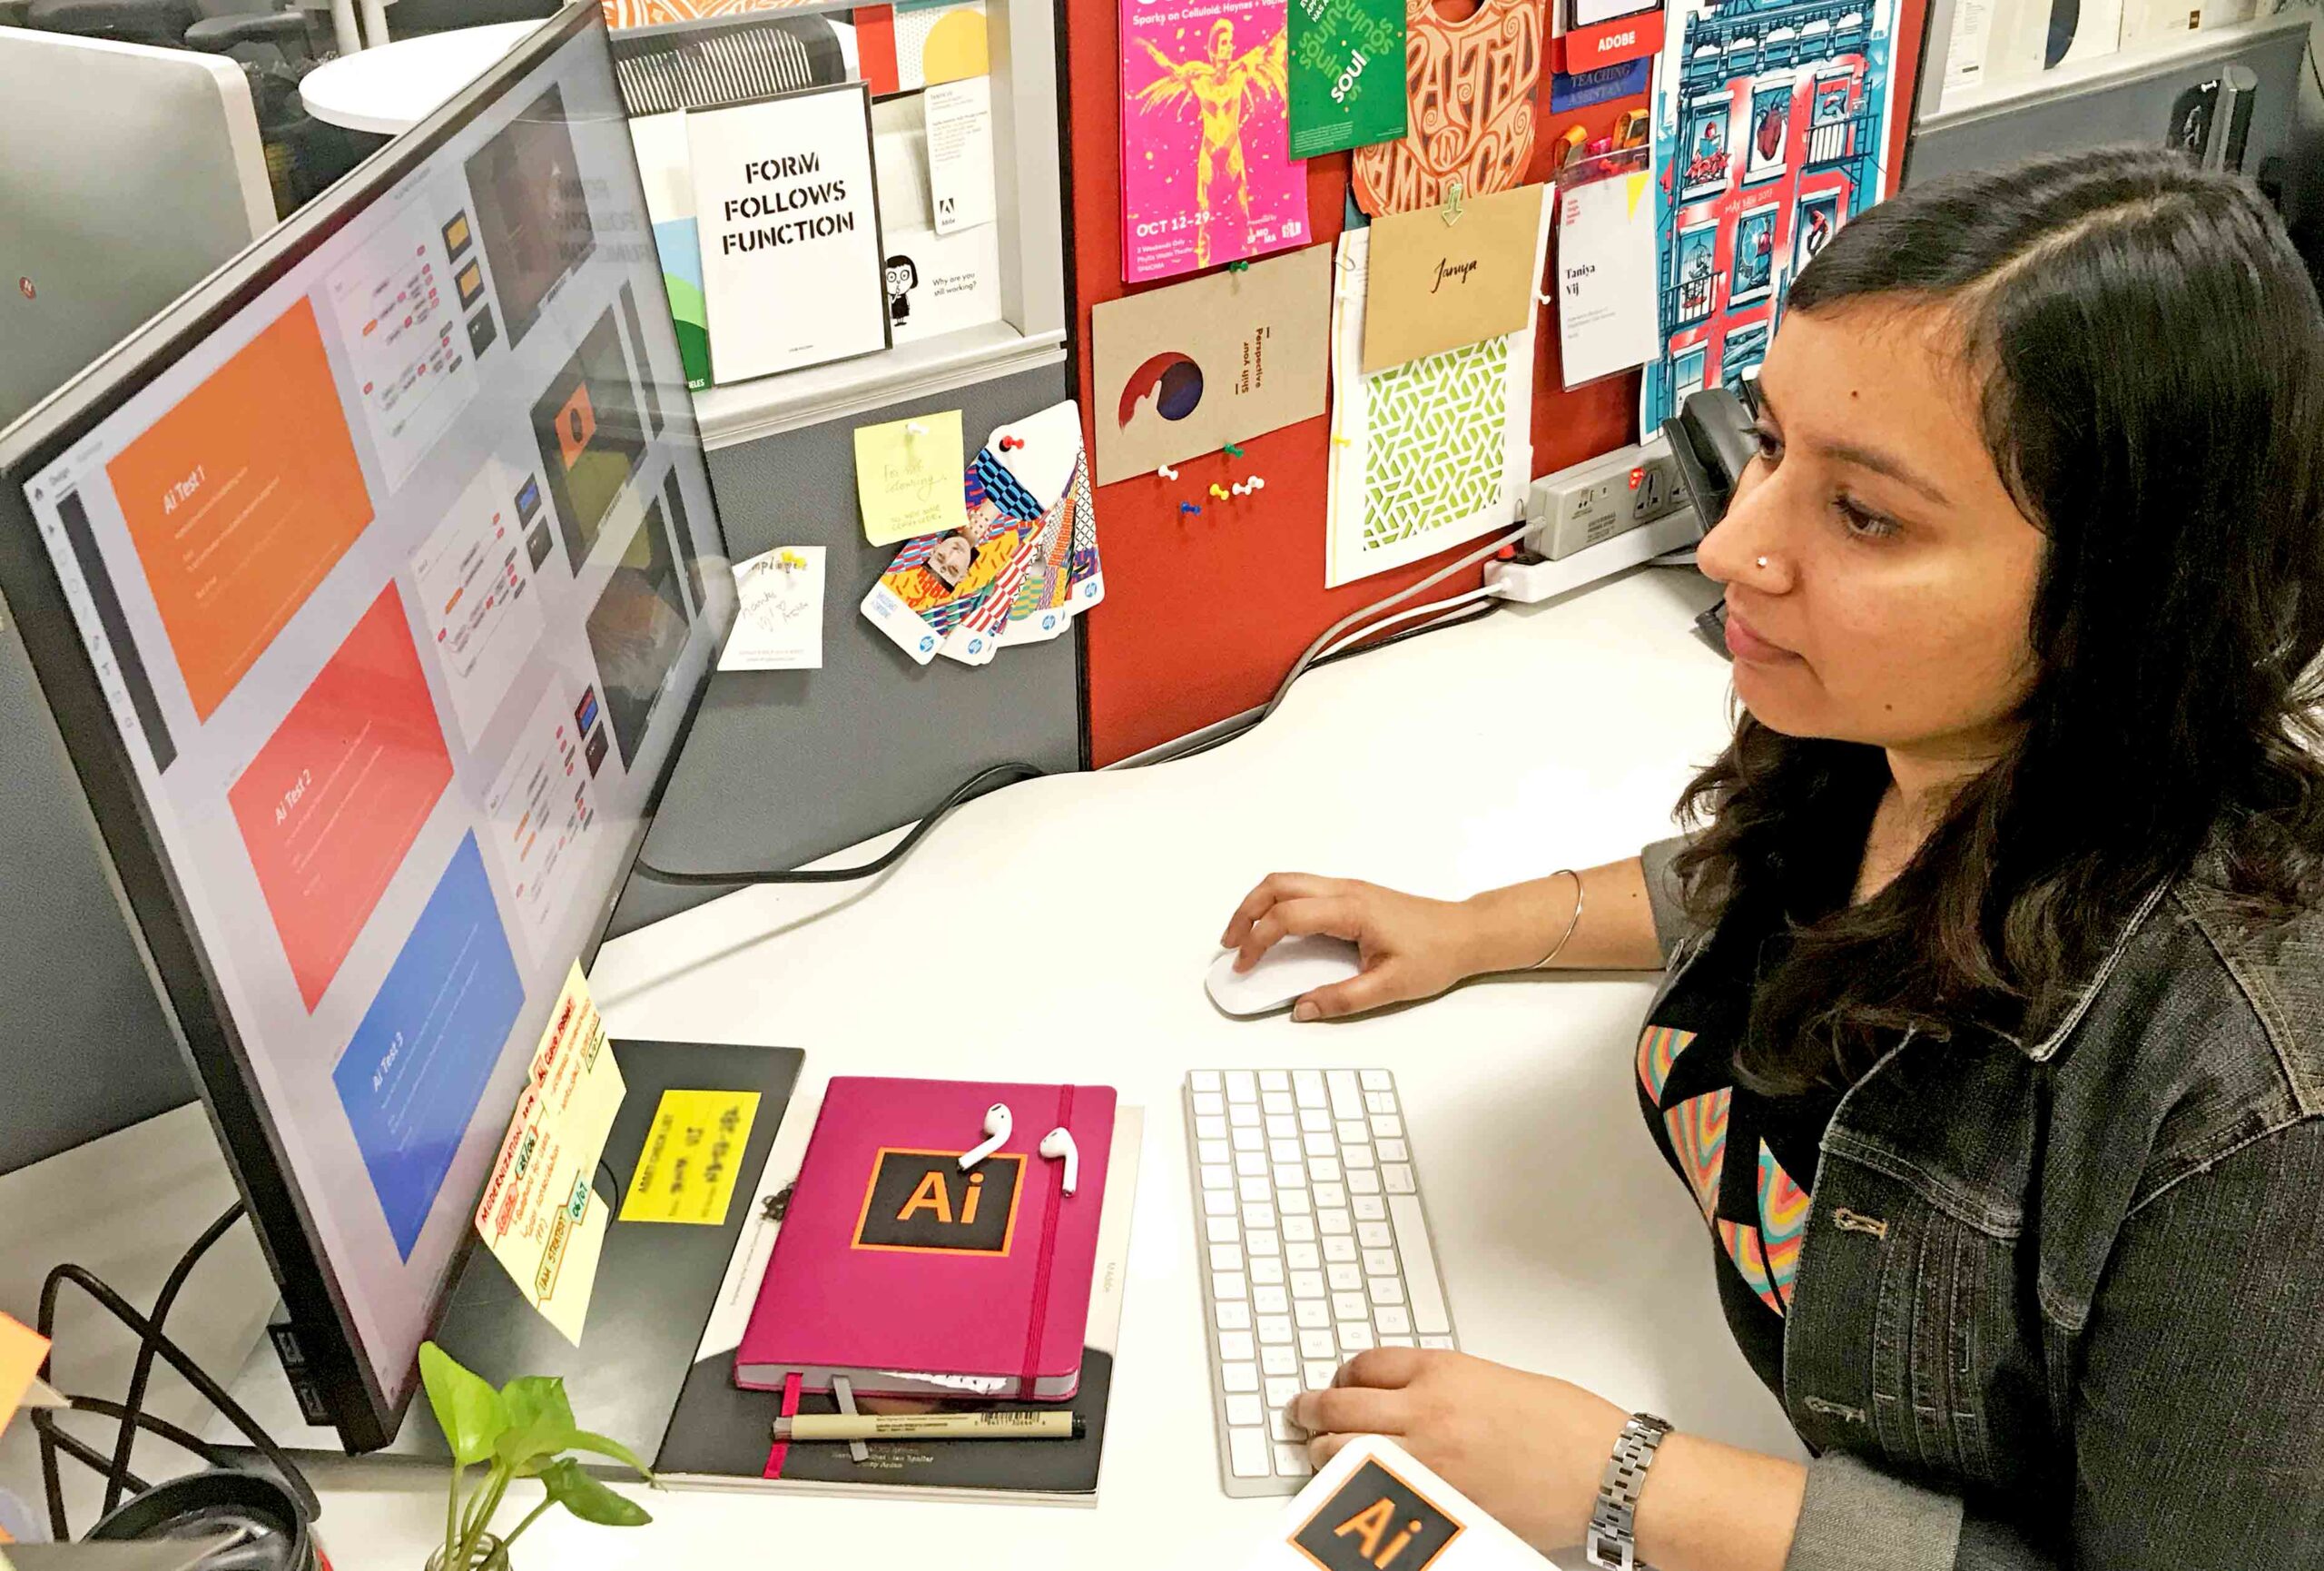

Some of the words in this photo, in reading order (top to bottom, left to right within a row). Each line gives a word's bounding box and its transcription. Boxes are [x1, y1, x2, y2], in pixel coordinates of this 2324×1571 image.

[1133, 15, 1166, 26] Sparks
[1167, 12, 1179, 21] on
[1598, 31, 1636, 52] ADOBE
[1331, 49, 1367, 104] soul
[1571, 64, 1630, 88] TEACHING
[746, 152, 819, 183] FORM
[725, 180, 846, 221] FOLLOWS
[723, 212, 853, 254] FUNCTION
[1137, 221, 1167, 237] OCT
[932, 277, 949, 287] Why
[950, 275, 960, 283] are
[962, 272, 975, 281] you
[934, 288, 945, 297] still
[946, 281, 977, 293] working?
[1566, 264, 1595, 280] Taniya
[1566, 282, 1580, 296] Vij
[1255, 328, 1263, 389] Perspective
[174, 470, 200, 501] Test
[196, 465, 205, 481] 1
[285, 777, 306, 809] Test
[302, 769, 312, 786] 2
[380, 1042, 399, 1074] Test
[396, 1032, 403, 1047] 3
[481, 1125, 522, 1223] MODERNIZATION
[571, 1181, 589, 1218] 06/07
[896, 1171, 984, 1224] Ai
[1334, 1497, 1423, 1570] Ai
